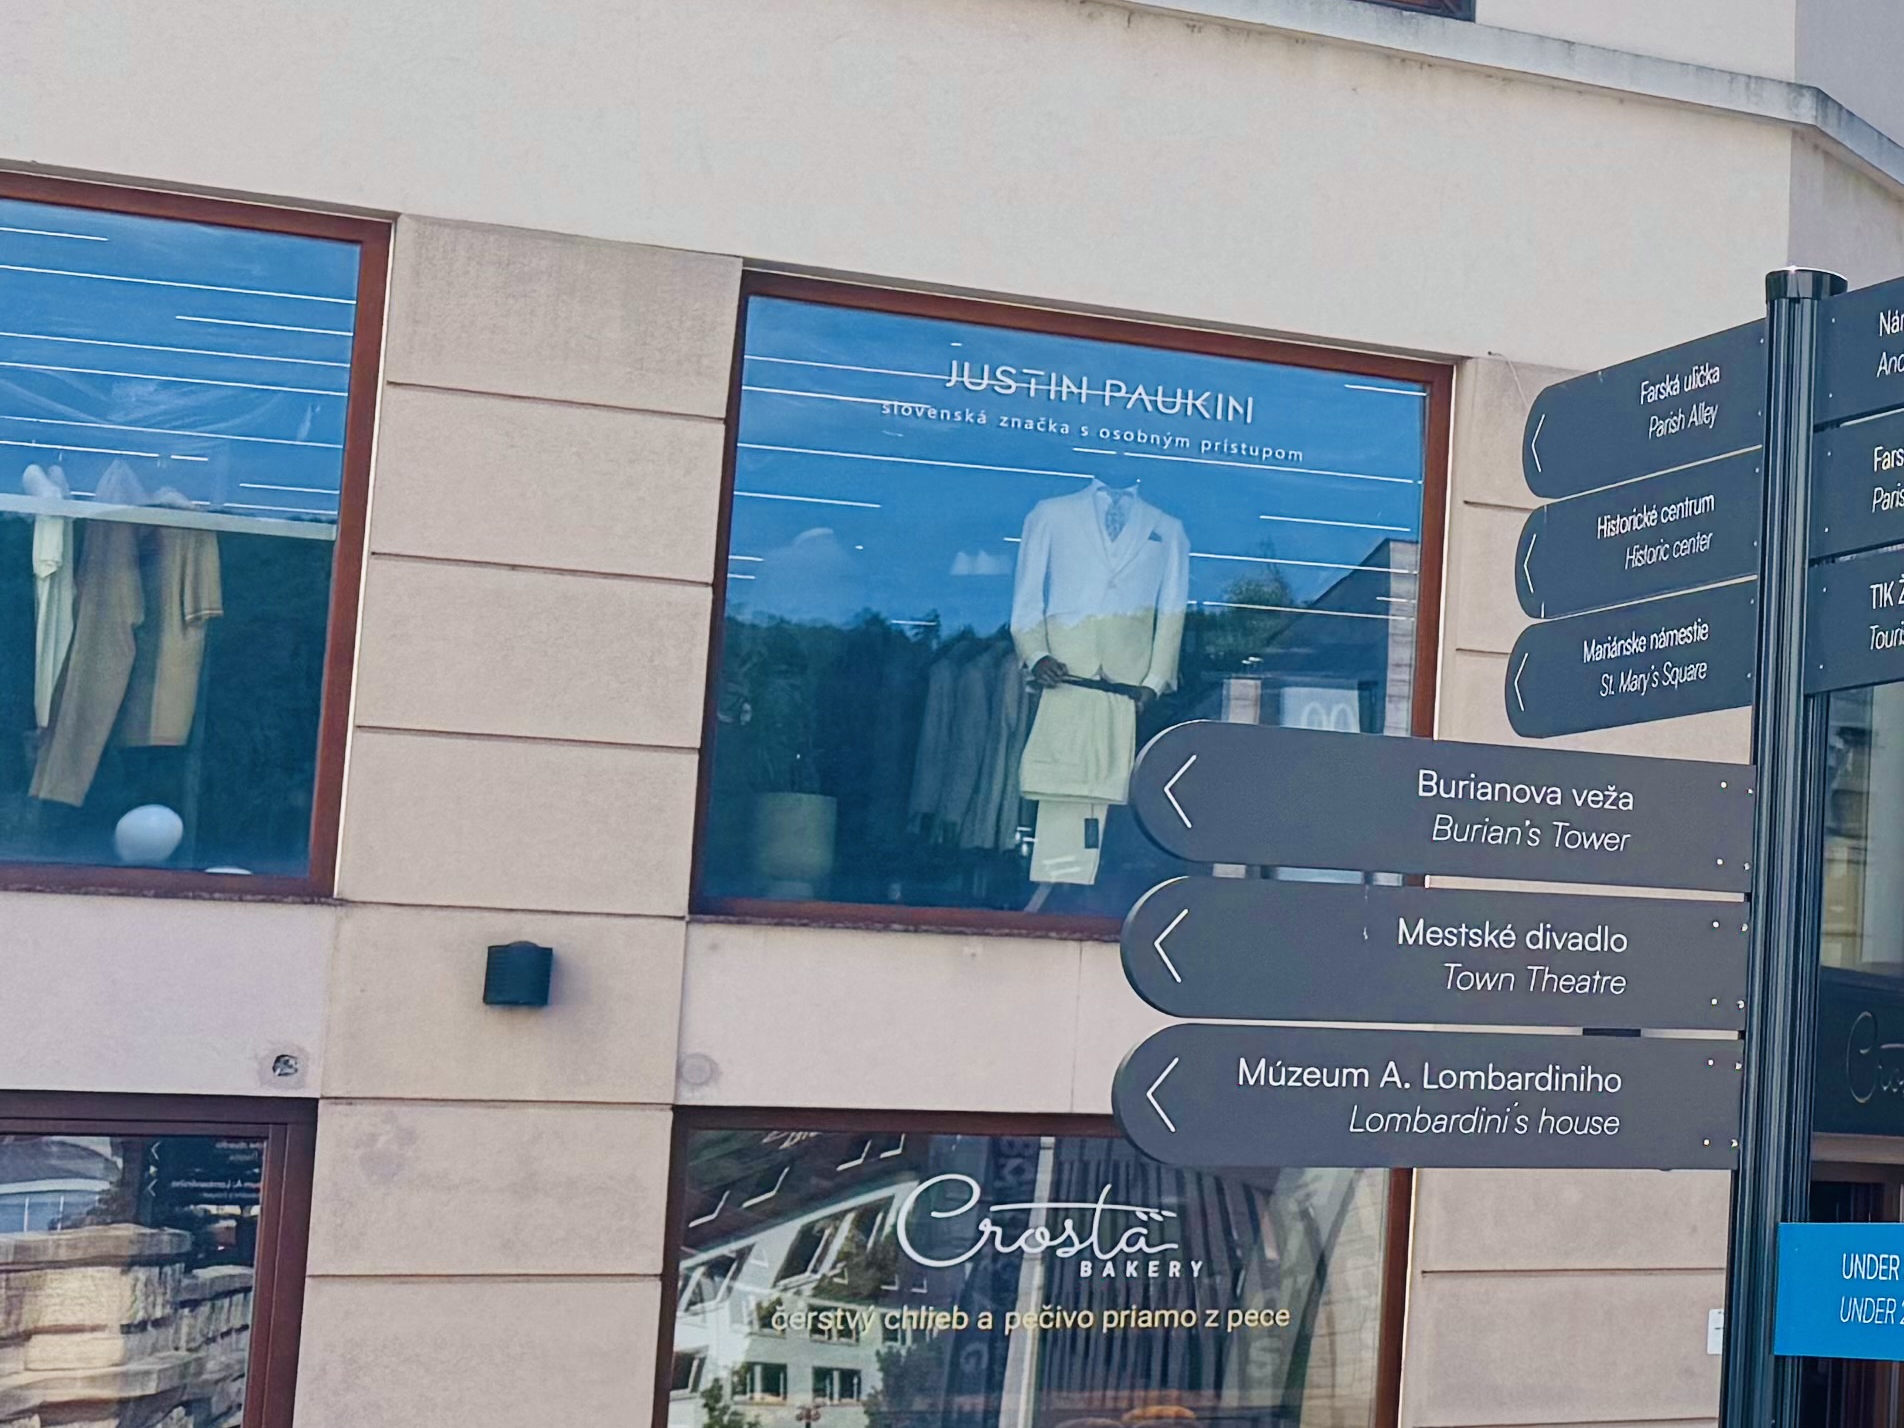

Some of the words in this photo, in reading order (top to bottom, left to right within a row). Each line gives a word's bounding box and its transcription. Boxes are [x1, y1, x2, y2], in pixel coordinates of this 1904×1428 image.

[945, 360, 1088, 404] JUSTIN
[1104, 379, 1253, 424] PAUKIN
[1640, 373, 1680, 405] Farská
[1683, 362, 1720, 392] ulička
[882, 400, 988, 424] slovenská
[999, 414, 1070, 435] značka
[1080, 426, 1089, 437] s
[1099, 425, 1190, 451] osobným
[1201, 437, 1303, 462] prístupom
[1648, 408, 1685, 440] Parish
[1687, 401, 1719, 429] Alley
[1597, 504, 1658, 540] Historické
[1660, 494, 1715, 524] centrum
[1624, 538, 1670, 570] Historic
[1672, 531, 1713, 558] center
[1869, 580, 1895, 610] TIK
[1583, 630, 1647, 664] Mariánske
[1649, 617, 1709, 650] námestie
[1599, 673, 1615, 697] St.
[1619, 664, 1660, 696] Mary's
[1662, 661, 1708, 691] Square
[1417, 768, 1562, 808] Burianova
[1571, 782, 1635, 811] veža
[1431, 814, 1542, 847] Burian's
[1551, 822, 1631, 853] Tower
[1397, 917, 1516, 951] Mestské
[1525, 920, 1628, 954] divadlo
[1443, 963, 1516, 993] Town
[1526, 965, 1627, 996] Theatre
[1237, 1057, 1370, 1090] Múzeum
[1380, 1060, 1412, 1090] A.
[1423, 1060, 1622, 1094] Lombardiniho
[1348, 1100, 1529, 1137] Lombardini's
[1539, 1113, 1620, 1137] house
[896, 1174, 1181, 1269] Crosta
[1079, 1259, 1204, 1279] BAKERY
[1841, 1252, 1899, 1282] UNDER
[771, 1304, 875, 1335] čerstvý
[884, 1304, 970, 1331] chlieb
[976, 1312, 993, 1329] a
[1004, 1305, 1095, 1337] pečivo
[1102, 1305, 1197, 1335] priamo
[1205, 1311, 1219, 1328] z
[1227, 1310, 1290, 1334] pece
[1839, 1296, 1895, 1324] UNDER
